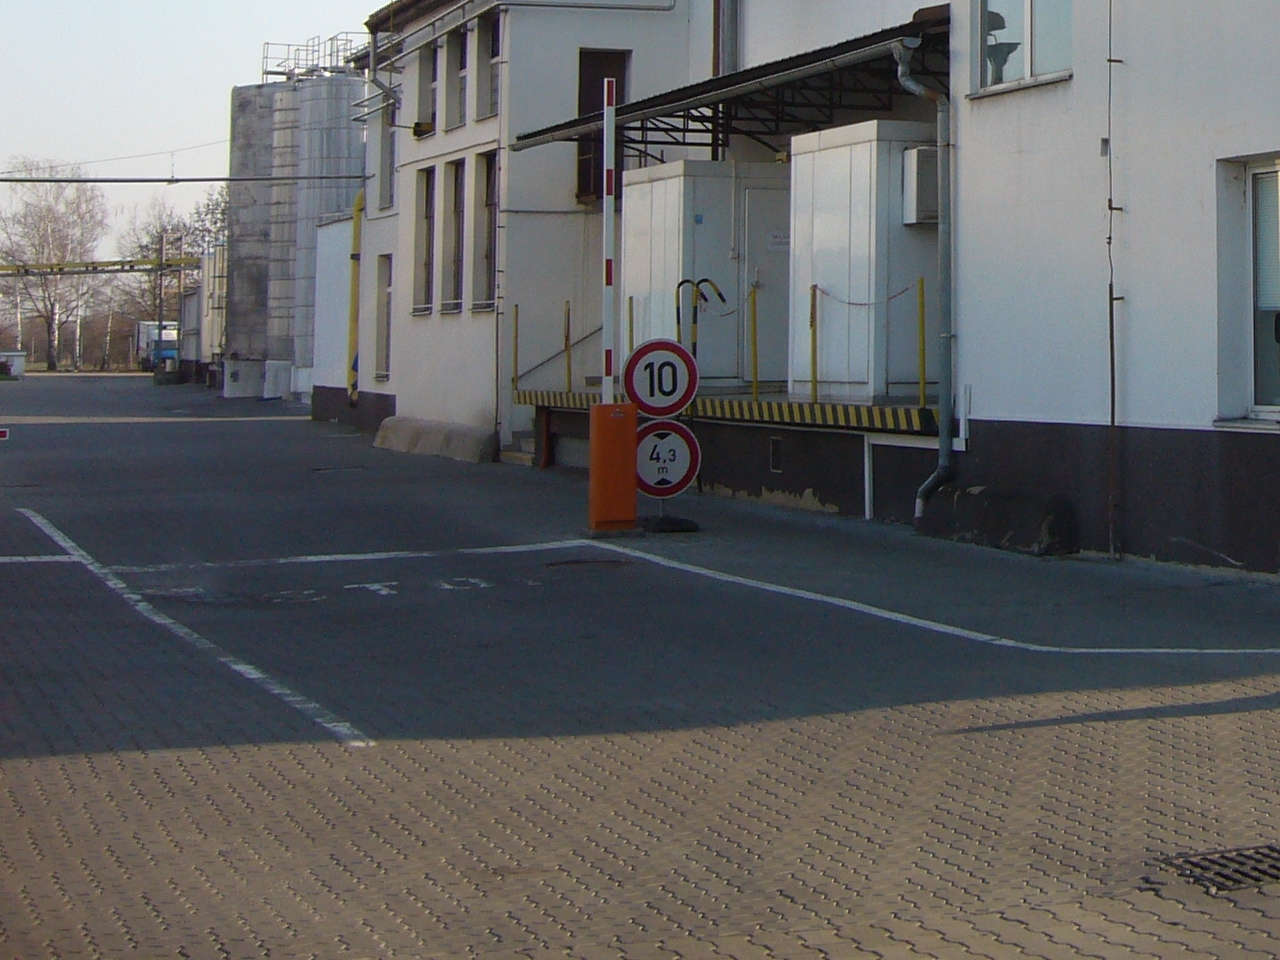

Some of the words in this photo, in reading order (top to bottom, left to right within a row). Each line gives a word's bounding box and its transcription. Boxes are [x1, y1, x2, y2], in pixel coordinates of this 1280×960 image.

[643, 361, 678, 397] 10
[649, 444, 677, 464] 4,3
[657, 465, 669, 474] m
